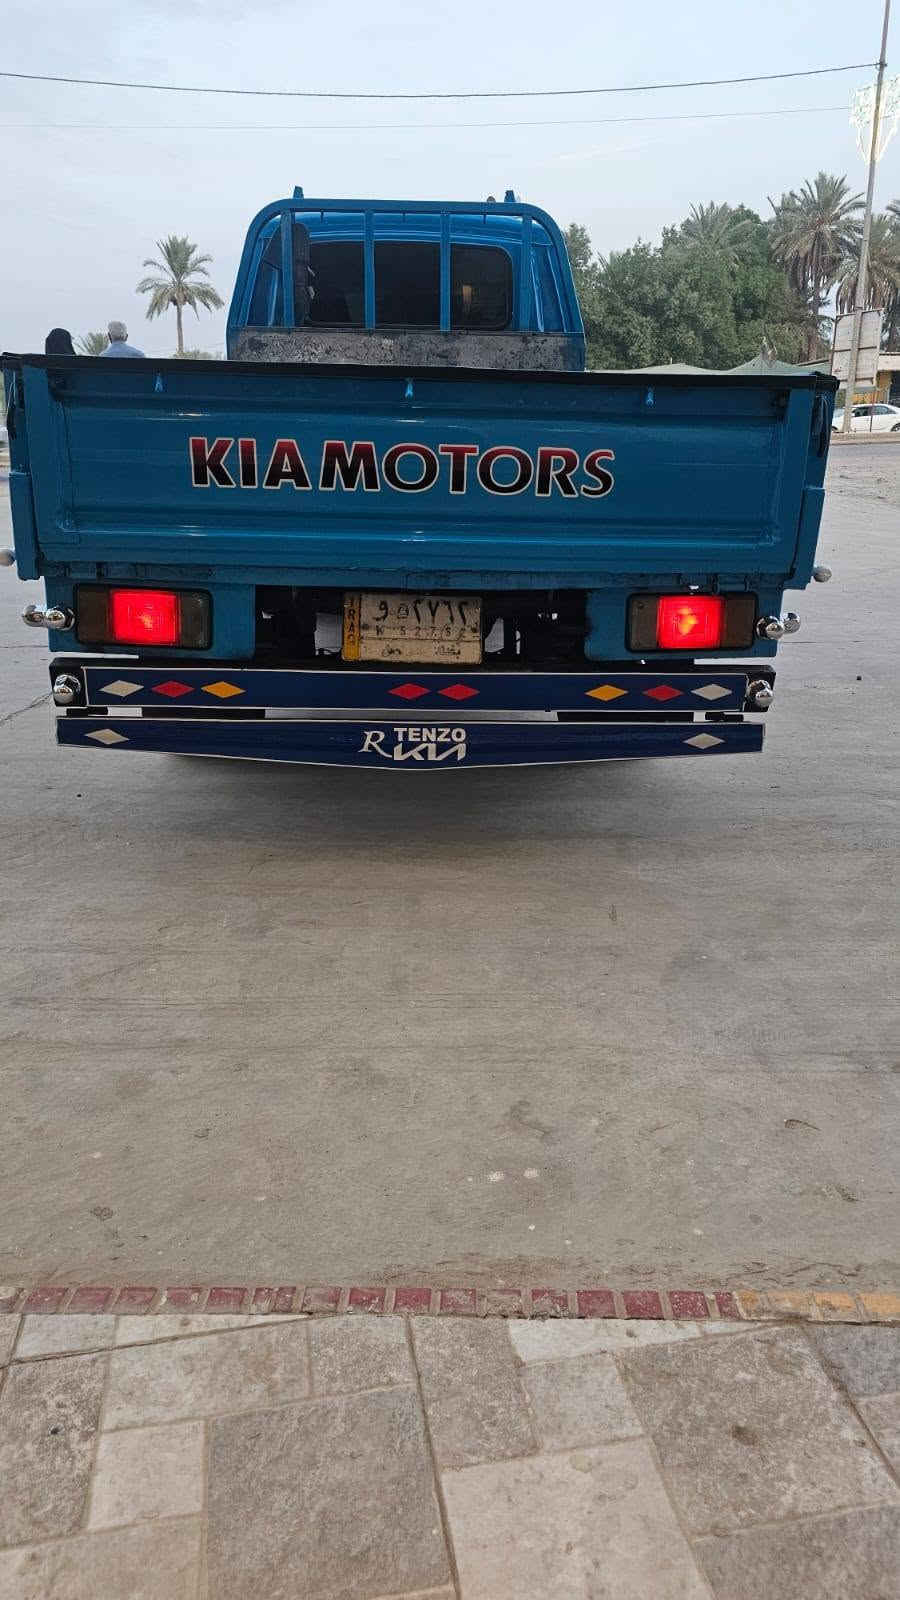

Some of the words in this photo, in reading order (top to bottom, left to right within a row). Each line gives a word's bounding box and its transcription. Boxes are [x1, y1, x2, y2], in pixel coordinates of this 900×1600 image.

[189, 436, 312, 490] KIA
[319, 441, 615, 498] MOTORS
[358, 730, 392, 758] R
[393, 727, 467, 742] TENZO
